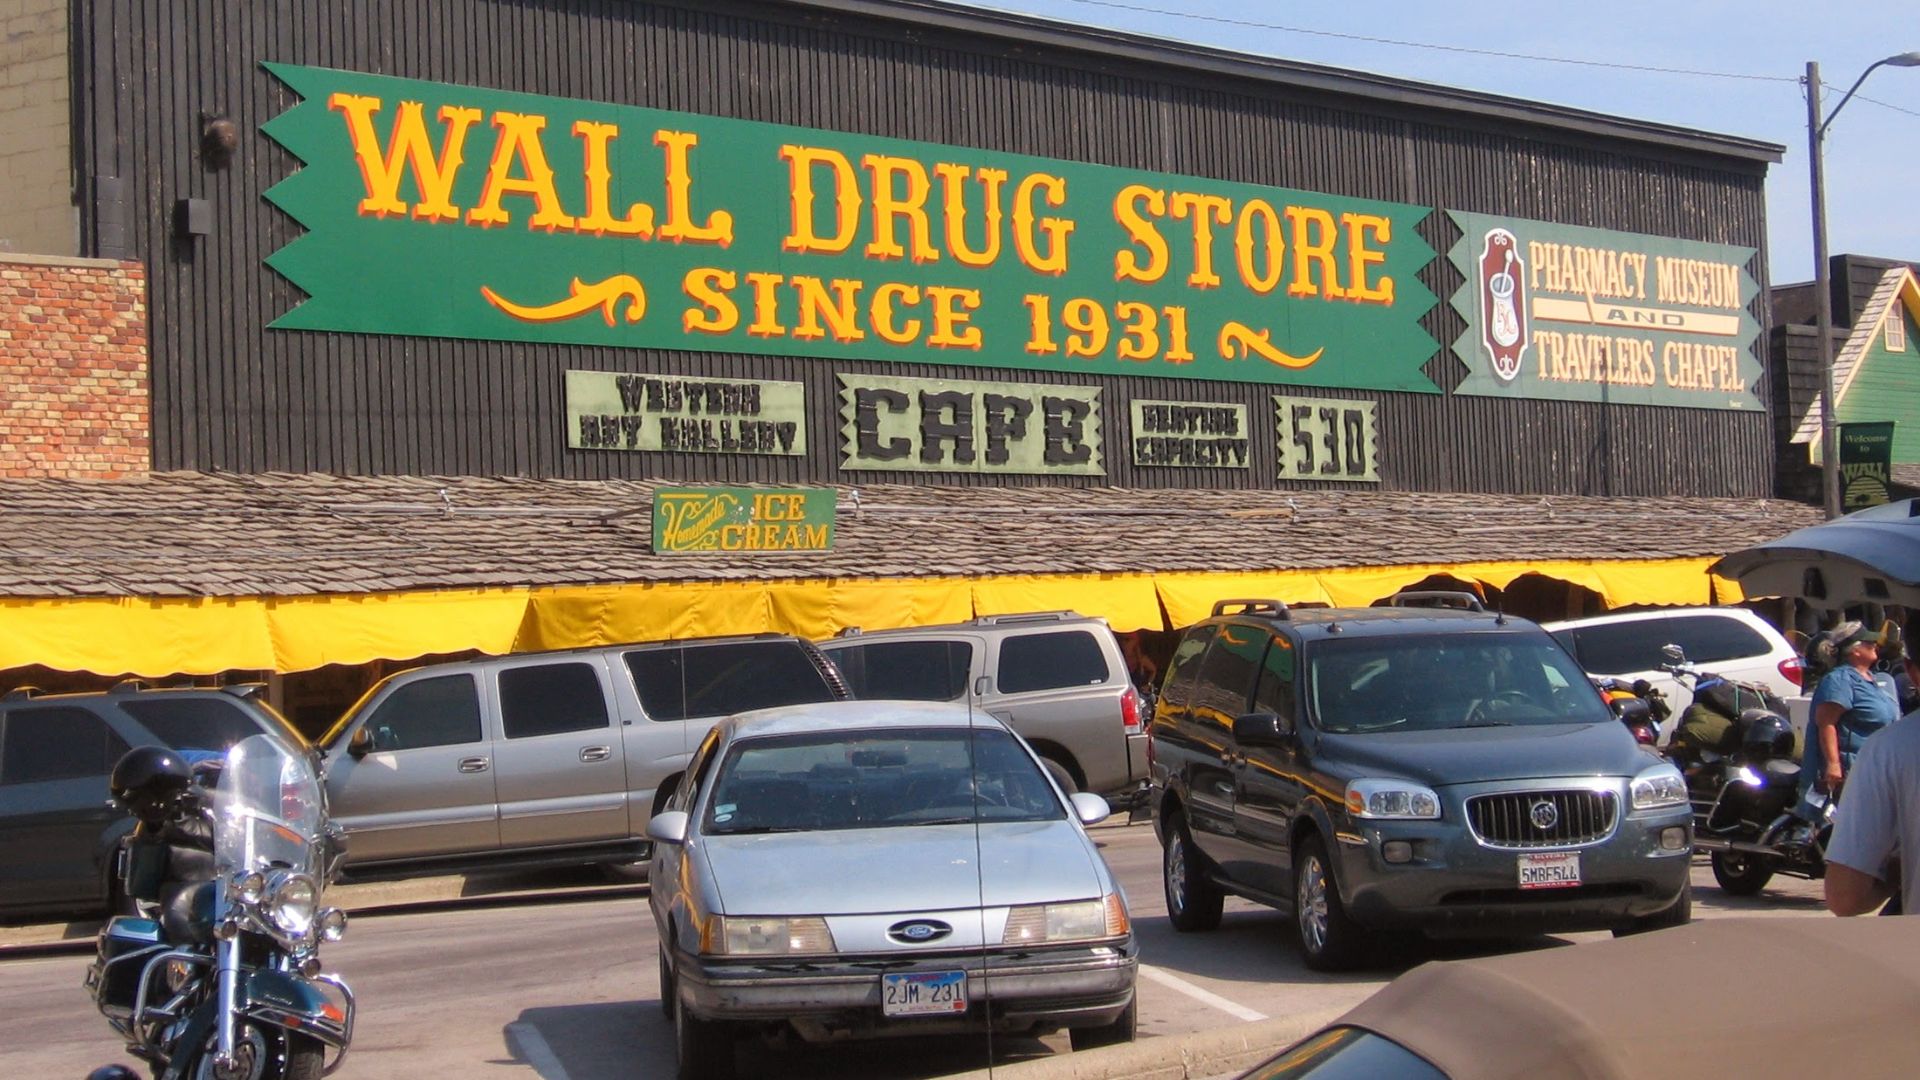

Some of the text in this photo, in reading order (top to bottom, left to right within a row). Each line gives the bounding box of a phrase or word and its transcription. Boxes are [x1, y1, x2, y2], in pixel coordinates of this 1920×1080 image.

[328, 93, 1395, 307] WALL DRUG STORE
[1529, 239, 1742, 310] PHARMACY MUSEUM
[682, 267, 1195, 364] SINCE 1931
[1606, 308, 1686, 327] AND
[1532, 330, 1745, 394] TRAVELERS CHAPEL
[616, 374, 761, 416] WESTERN
[579, 414, 798, 454] ART GALLERY
[853, 387, 1093, 467] CAFE
[1141, 404, 1239, 436] SEATING
[1291, 403, 1367, 476] 530
[1136, 437, 1249, 467] CAPACITY
[1842, 462, 1888, 484] WALL
[660, 494, 730, 551] Homemade
[751, 493, 807, 522] ICE
[720, 523, 830, 551] CREAM
[886, 982, 962, 1005] 2JM 231
